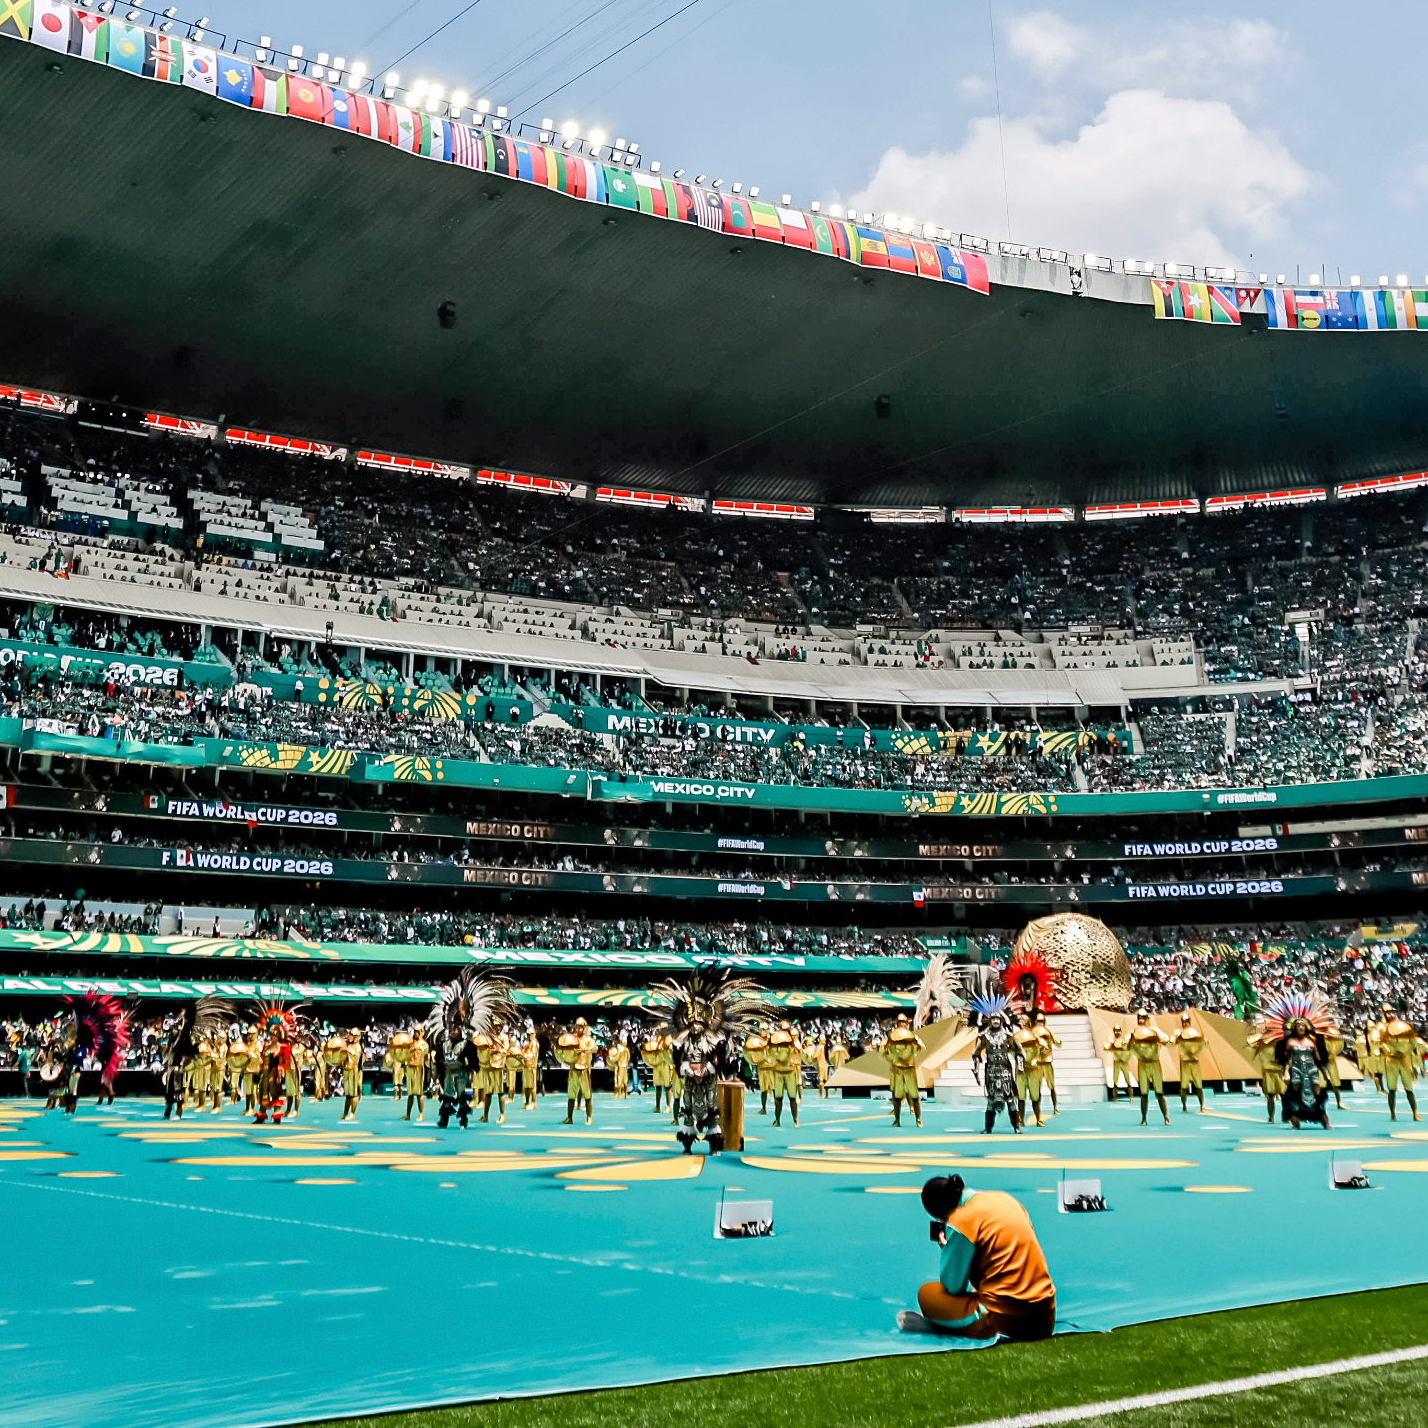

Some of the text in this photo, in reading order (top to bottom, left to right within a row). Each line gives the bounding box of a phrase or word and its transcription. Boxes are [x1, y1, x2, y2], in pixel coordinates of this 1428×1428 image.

[607, 714, 710, 739] MEXCO
[650, 781, 756, 798] MEXICO CITY
[1217, 792, 1277, 804] #FIFAWorldCup
[168, 800, 338, 826] FIFA WORL CUP 2026
[717, 838, 764, 851] #FIFAWorldCup
[1124, 838, 1278, 856] FIFA WORLD CUP 2026
[162, 851, 334, 875] FA WORLD CUP 2026
[1128, 881, 1284, 898] FIFA WORLD CUP 2026
[466, 950, 806, 966] MEXICO CITY
[62, 980, 127, 992] DE
[128, 982, 194, 994] LA
[192, 984, 292, 995] FIFA
[291, 983, 437, 999] 2026
